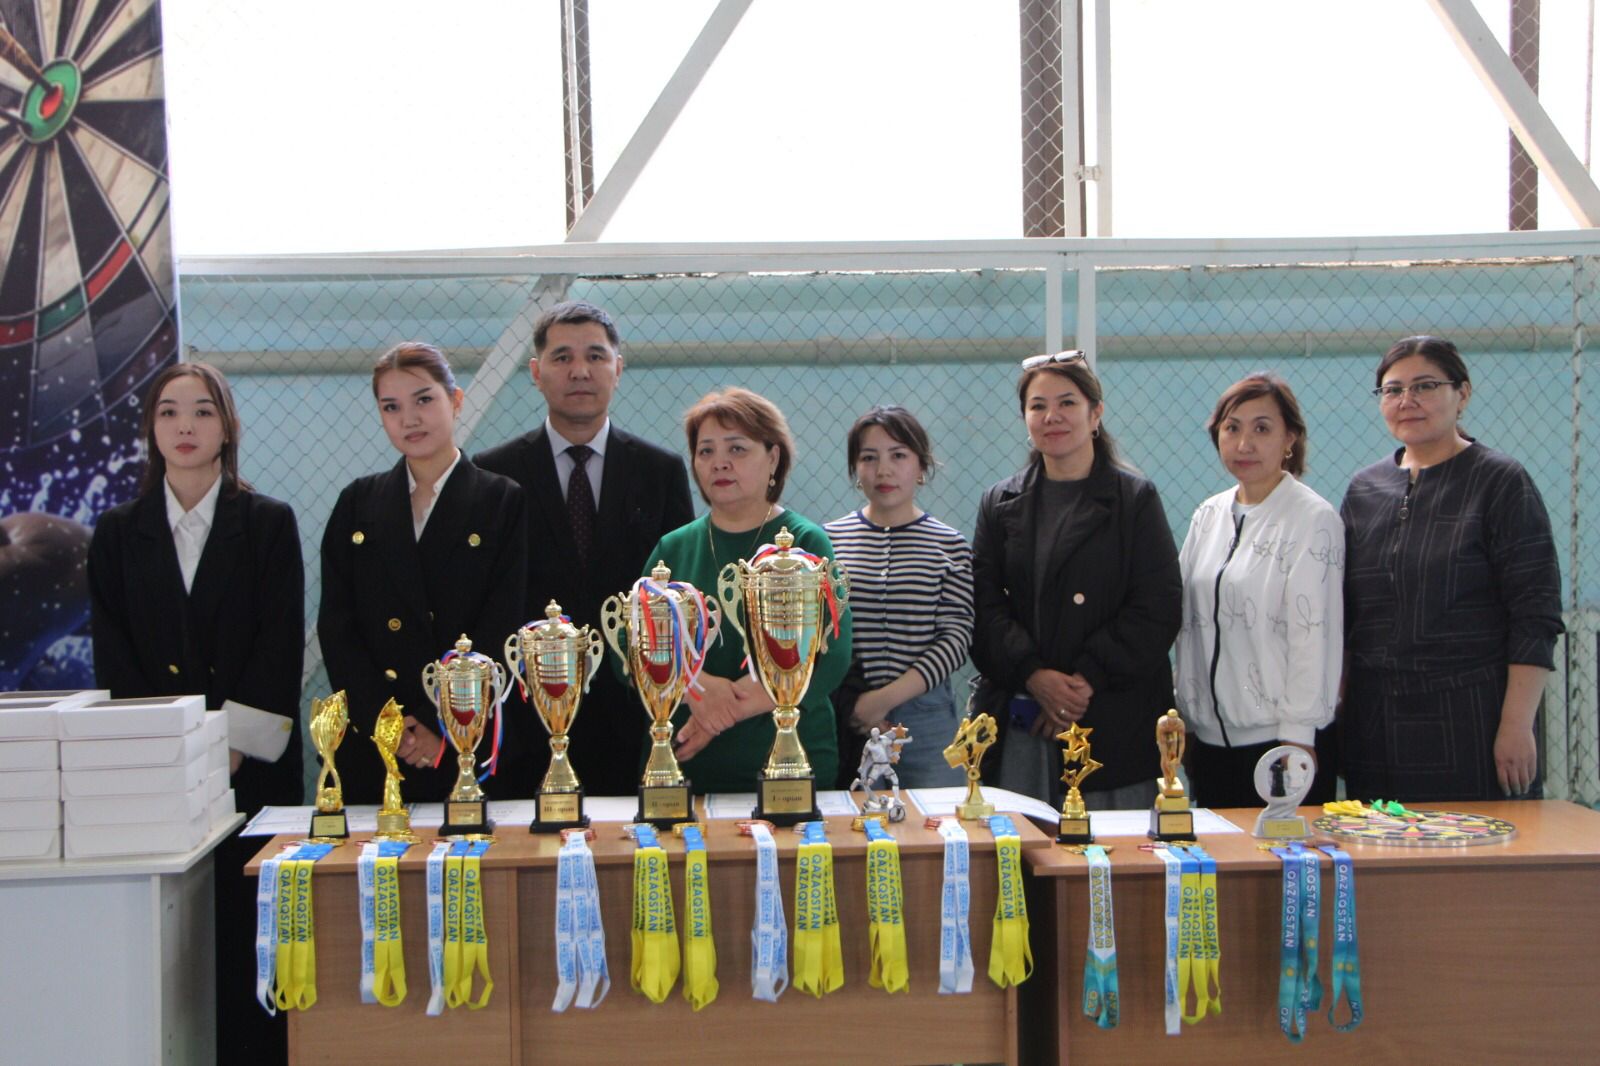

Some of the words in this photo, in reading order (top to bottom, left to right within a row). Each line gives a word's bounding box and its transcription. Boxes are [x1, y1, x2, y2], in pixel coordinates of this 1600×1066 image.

[280, 868, 292, 944] QAZAQSTAN
[297, 867, 310, 942] QAZAQSTAN
[376, 866, 388, 942] QAZAQSTAN
[447, 867, 460, 942] QAZAQSTAN
[463, 868, 477, 944] QAZAQSTAN
[648, 856, 659, 931] QAZAQSTAN
[692, 862, 704, 937] QAZAQSTAN
[798, 856, 810, 930] QAZAQSTAN
[811, 853, 822, 929] QAZAQSTAN
[877, 848, 894, 923] QAZAQSTAN
[999, 846, 1015, 919] QAZAQSTAN
[1180, 886, 1194, 959] QAZAQSTAN
[1204, 886, 1219, 959] QAZAQSTAN
